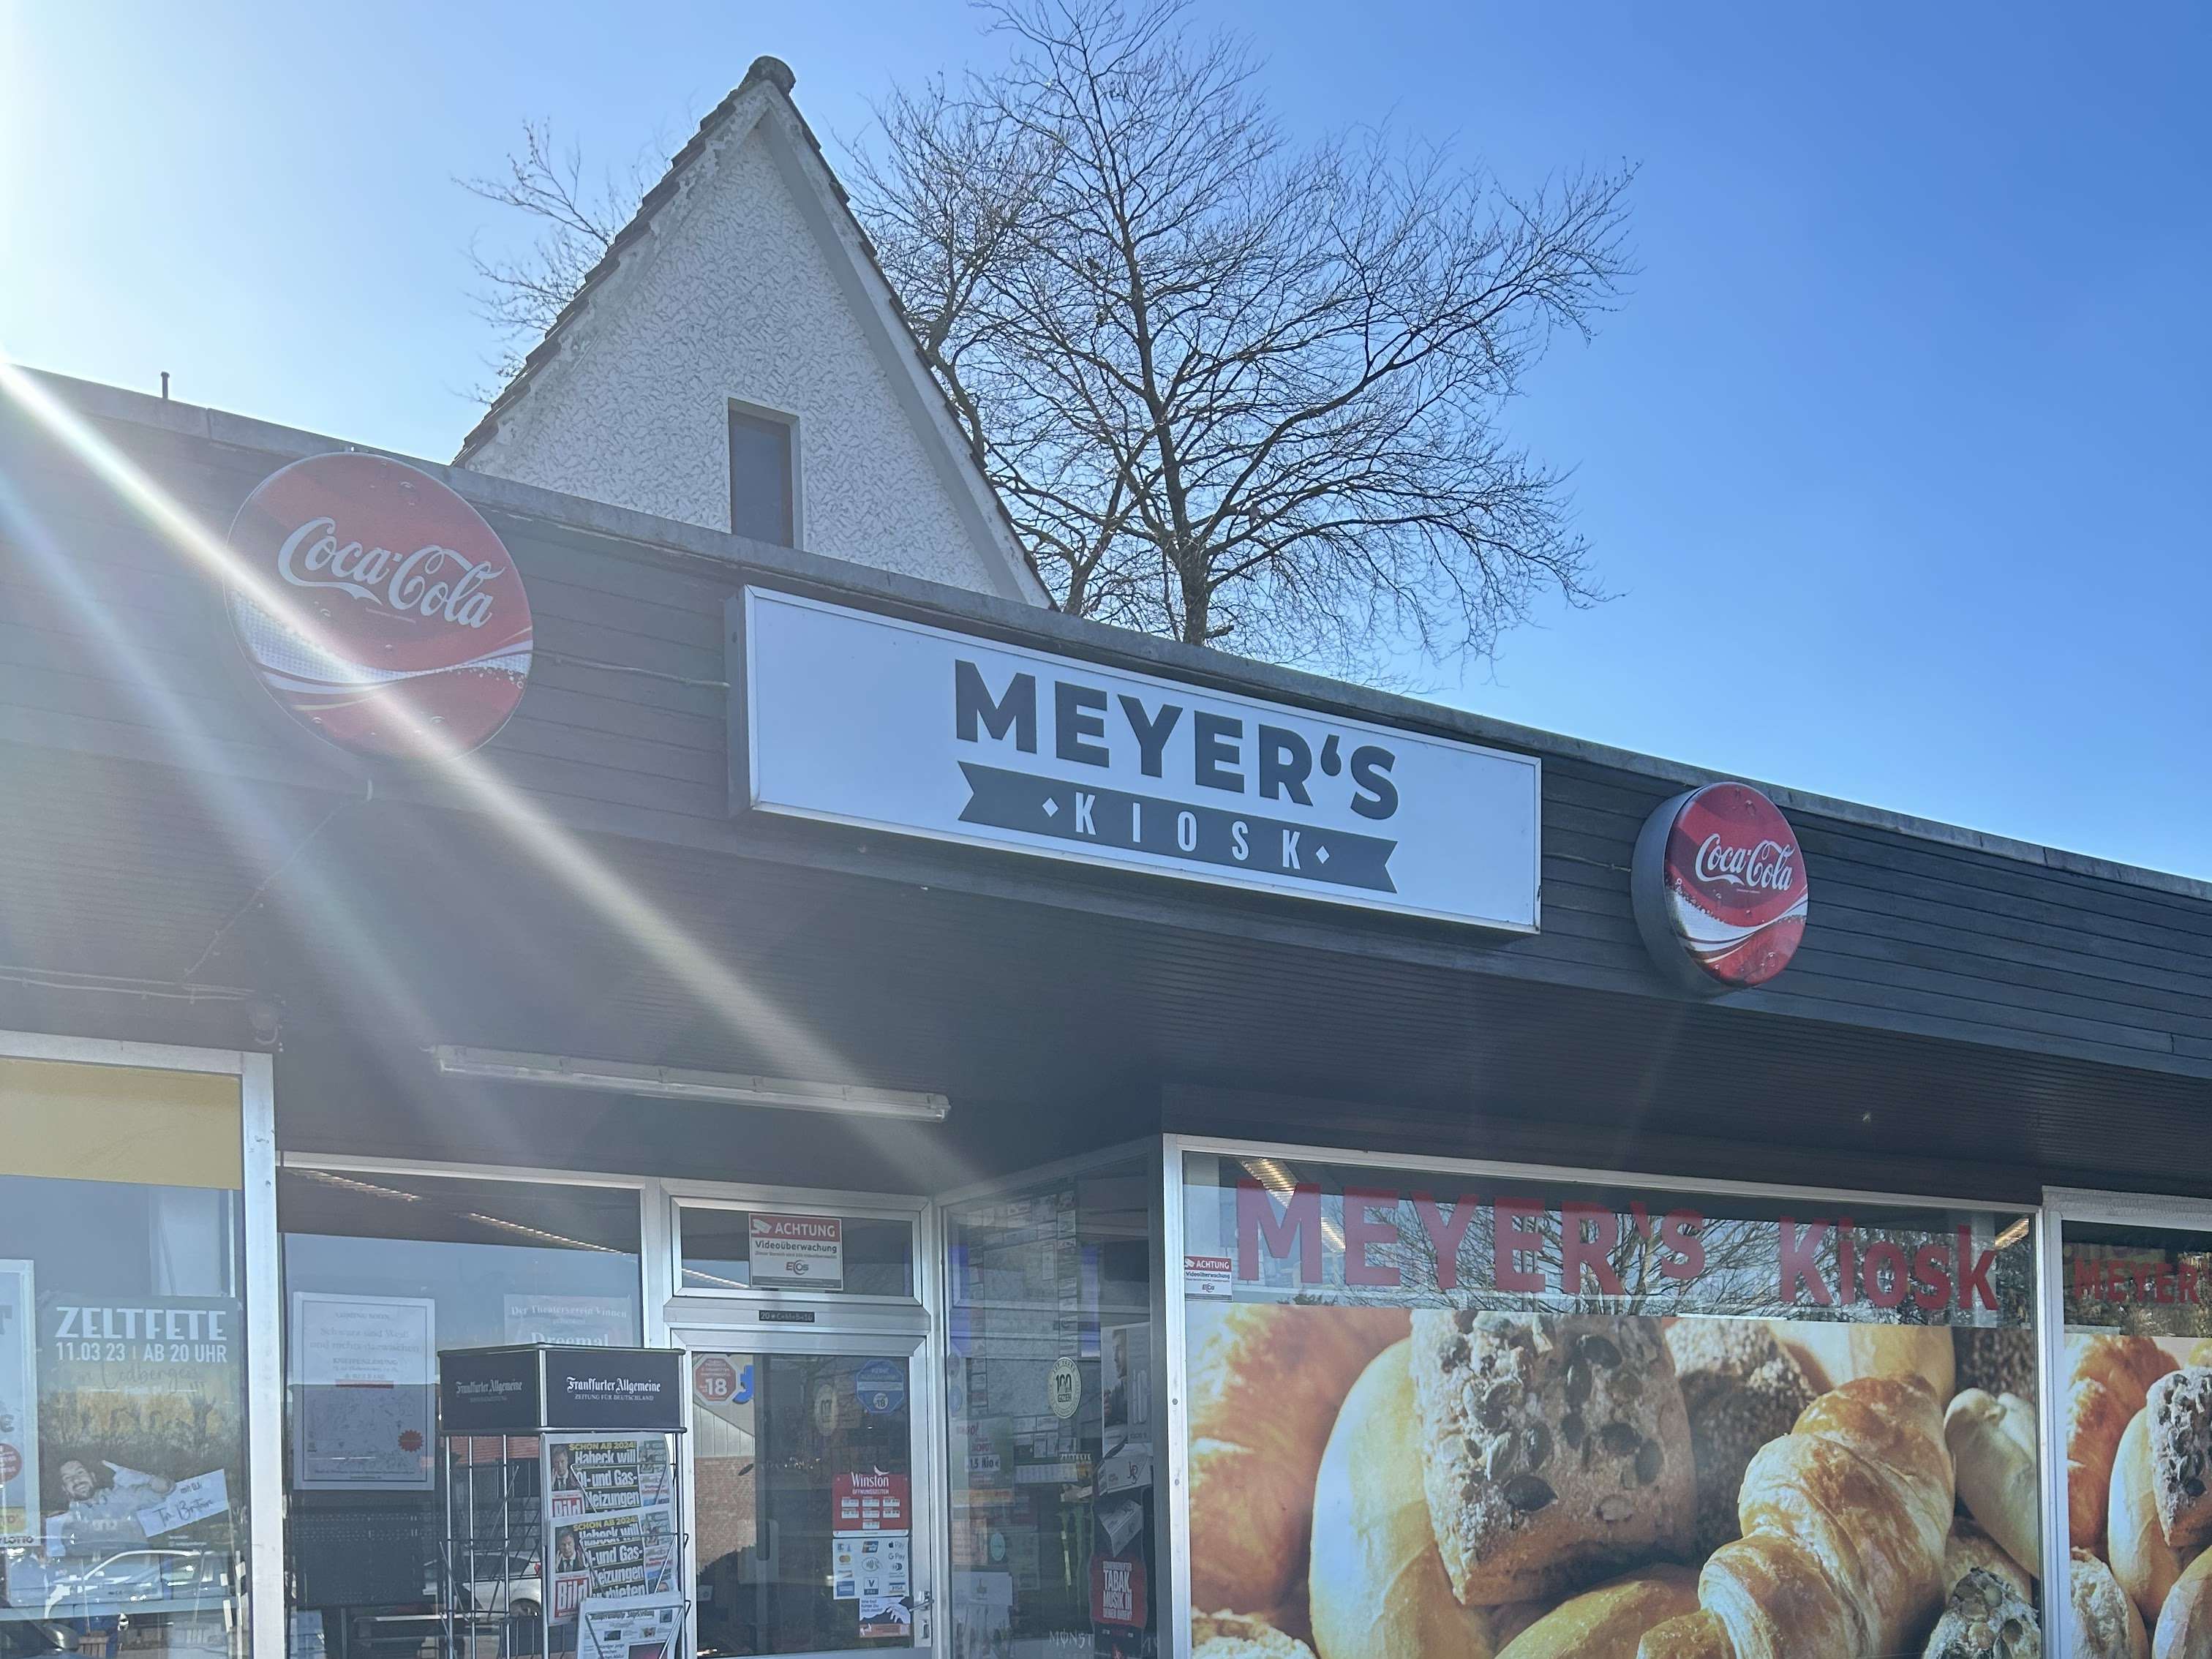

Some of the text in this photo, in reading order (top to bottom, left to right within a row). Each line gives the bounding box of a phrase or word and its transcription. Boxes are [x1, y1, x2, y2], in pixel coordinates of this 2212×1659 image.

[278, 517, 505, 628] Coca-Cola
[1076, 792, 1301, 870] KIOSK
[1696, 833, 1795, 890] Coca-Cola
[775, 1222, 835, 1237] ACHTUNG
[755, 1241, 837, 1254] Videoüberwachung
[1196, 1260, 1230, 1269] ACHTUNG
[1779, 1216, 1999, 1311] Kiosk
[511, 1306, 528, 1316] Der
[55, 1306, 227, 1341] ZELTFETE
[143, 1344, 164, 1362] AB
[170, 1344, 189, 1362] 20
[195, 1344, 227, 1363] UHR
[615, 1377, 661, 1394] Allgemeine
[705, 1377, 727, 1396] 18
[617, 1449, 636, 1464] will
[592, 1470, 612, 1488] und
[614, 1469, 638, 1487] Gas-
[851, 1470, 889, 1487] Winston
[586, 1491, 640, 1508] Heizungen
[573, 1521, 602, 1532] SCHON
[603, 1520, 615, 1529] AB
[596, 1546, 617, 1565] und
[619, 1545, 643, 1562] Gas-
[559, 1579, 588, 1609] Bild
